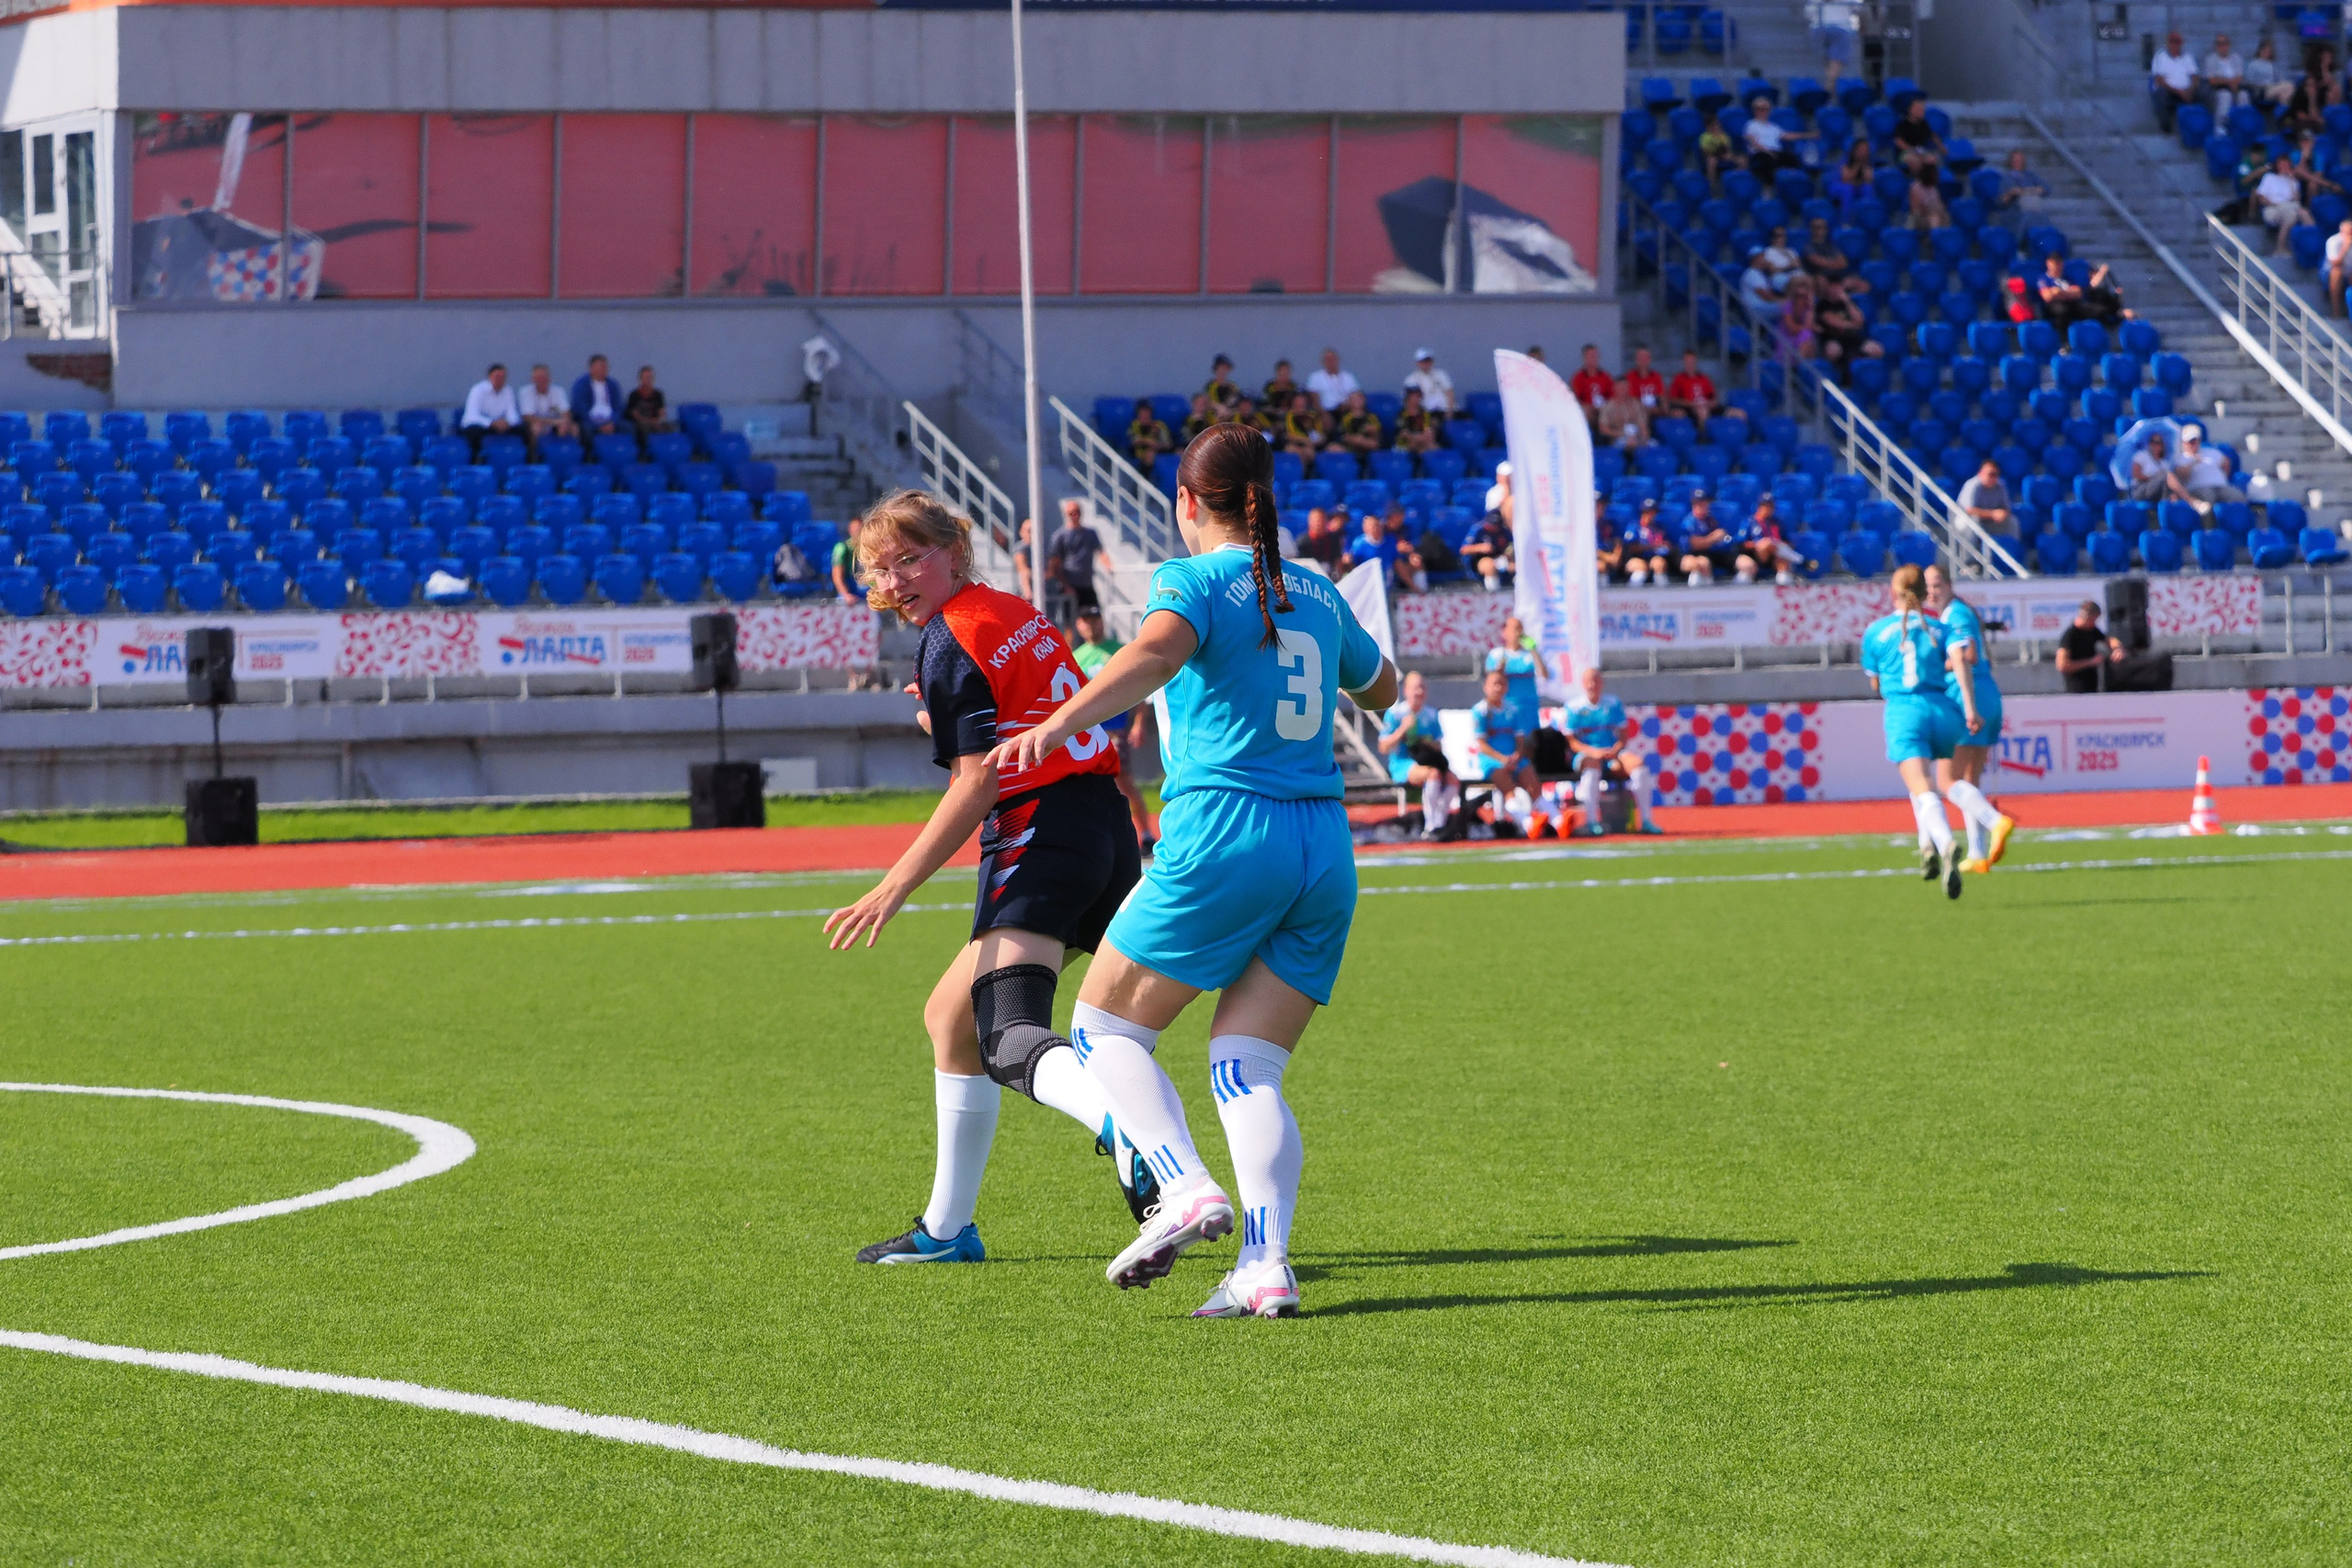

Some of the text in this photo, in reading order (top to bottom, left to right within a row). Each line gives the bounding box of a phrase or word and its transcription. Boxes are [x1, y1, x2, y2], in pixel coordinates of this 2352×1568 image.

[523, 637, 605, 663] ЛАПТА
[989, 615, 1057, 669] КРАСНОЯРС
[1032, 635, 1059, 661] КАЙ
[1275, 628, 1323, 741] 3
[2077, 750, 2119, 772] 2025
